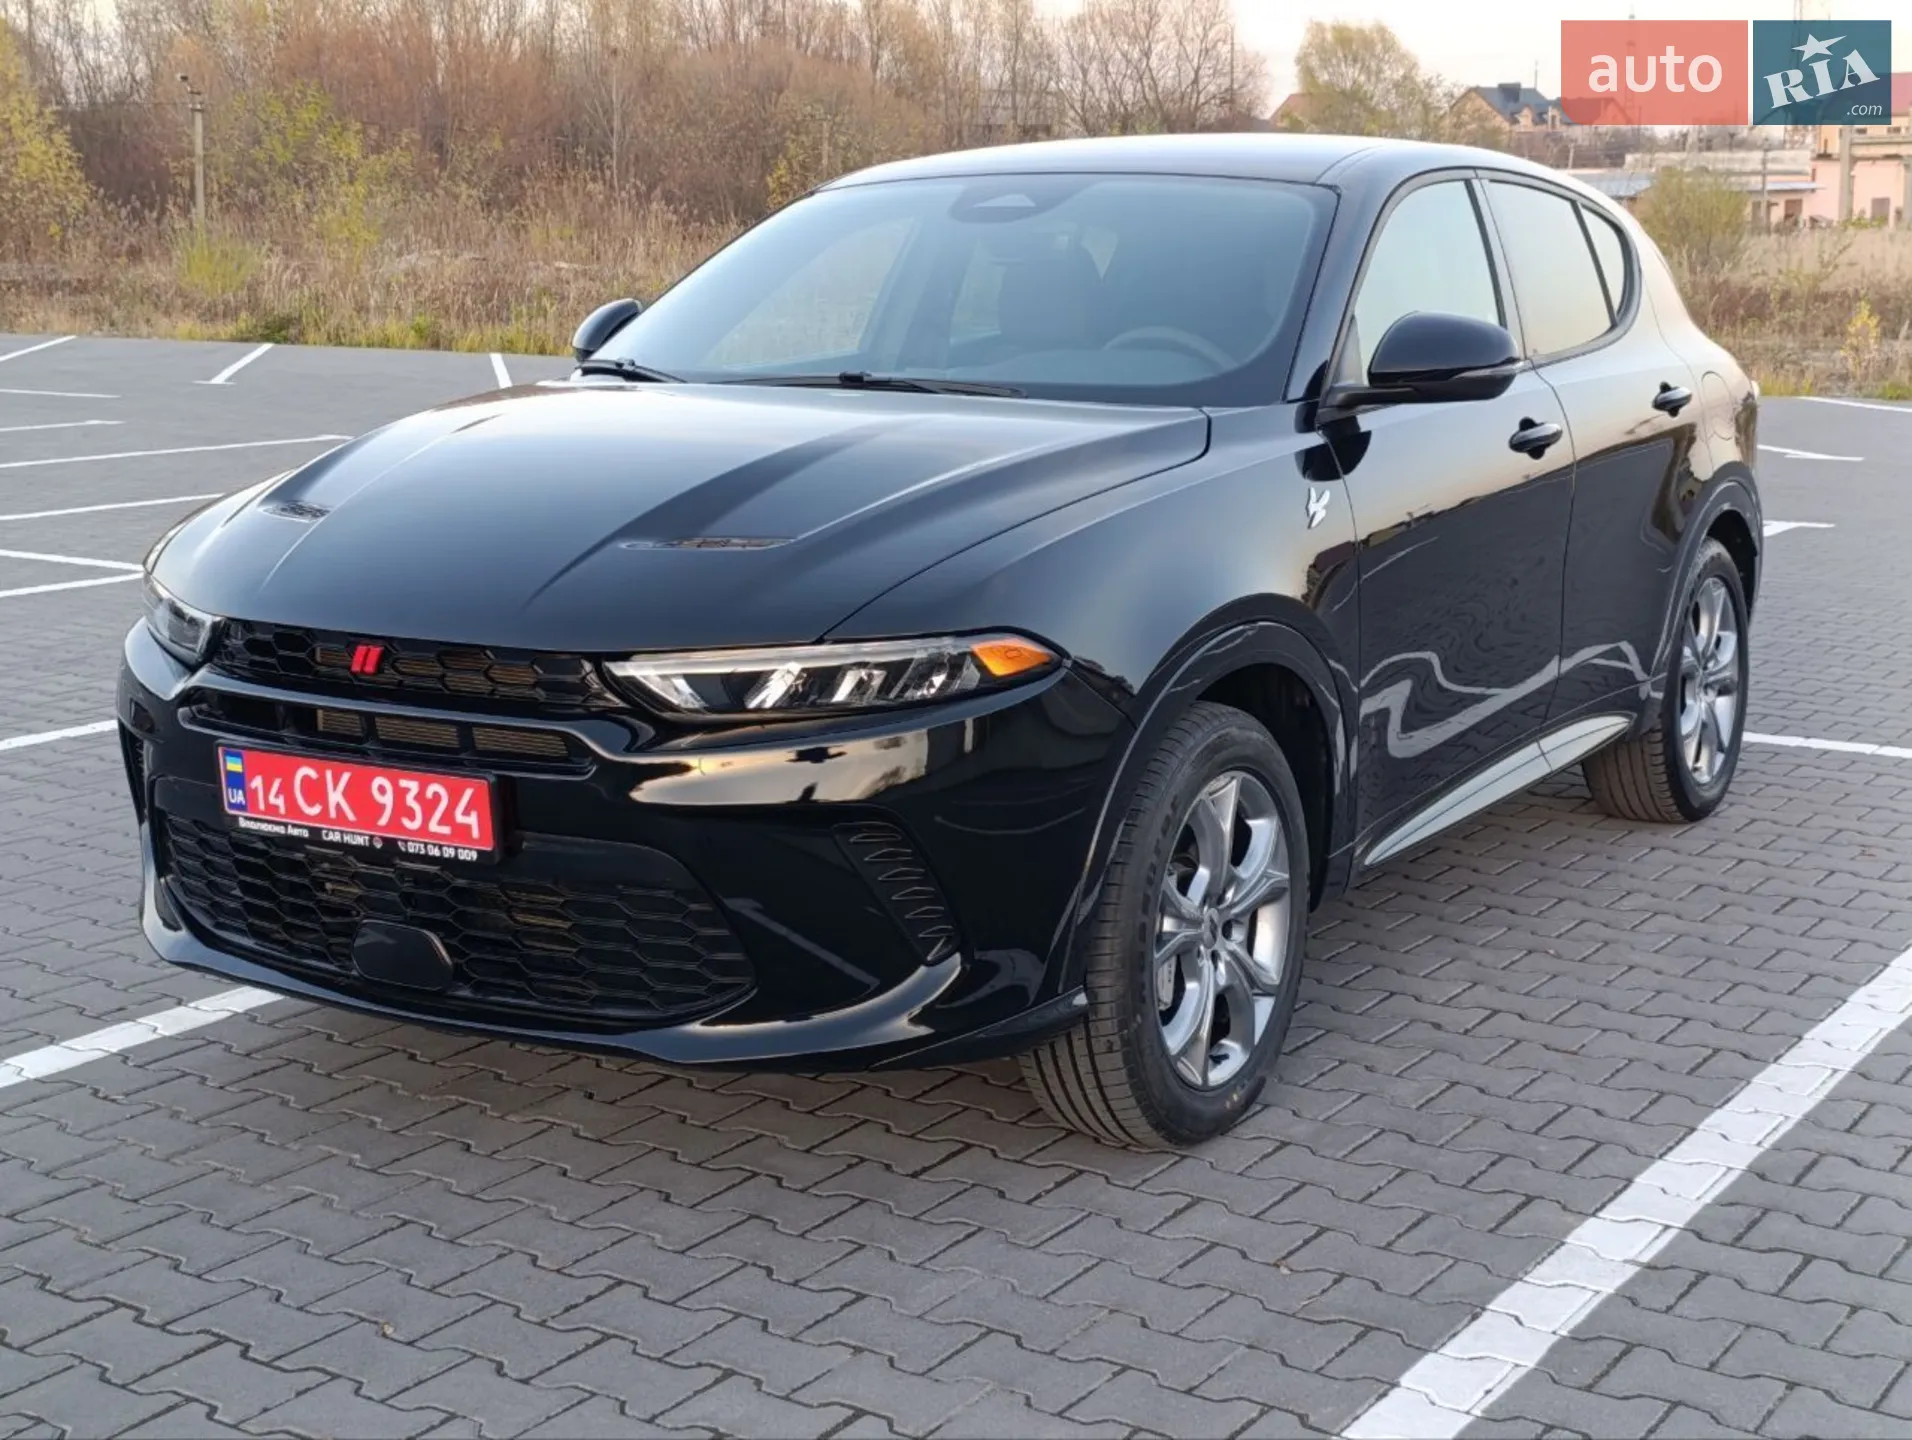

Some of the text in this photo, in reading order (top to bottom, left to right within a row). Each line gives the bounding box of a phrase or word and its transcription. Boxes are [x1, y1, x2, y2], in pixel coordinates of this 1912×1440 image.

[227, 787, 246, 806] UA
[250, 775, 286, 815] 14
[371, 776, 480, 840] 9324
[321, 829, 370, 847] CAR HUNT
